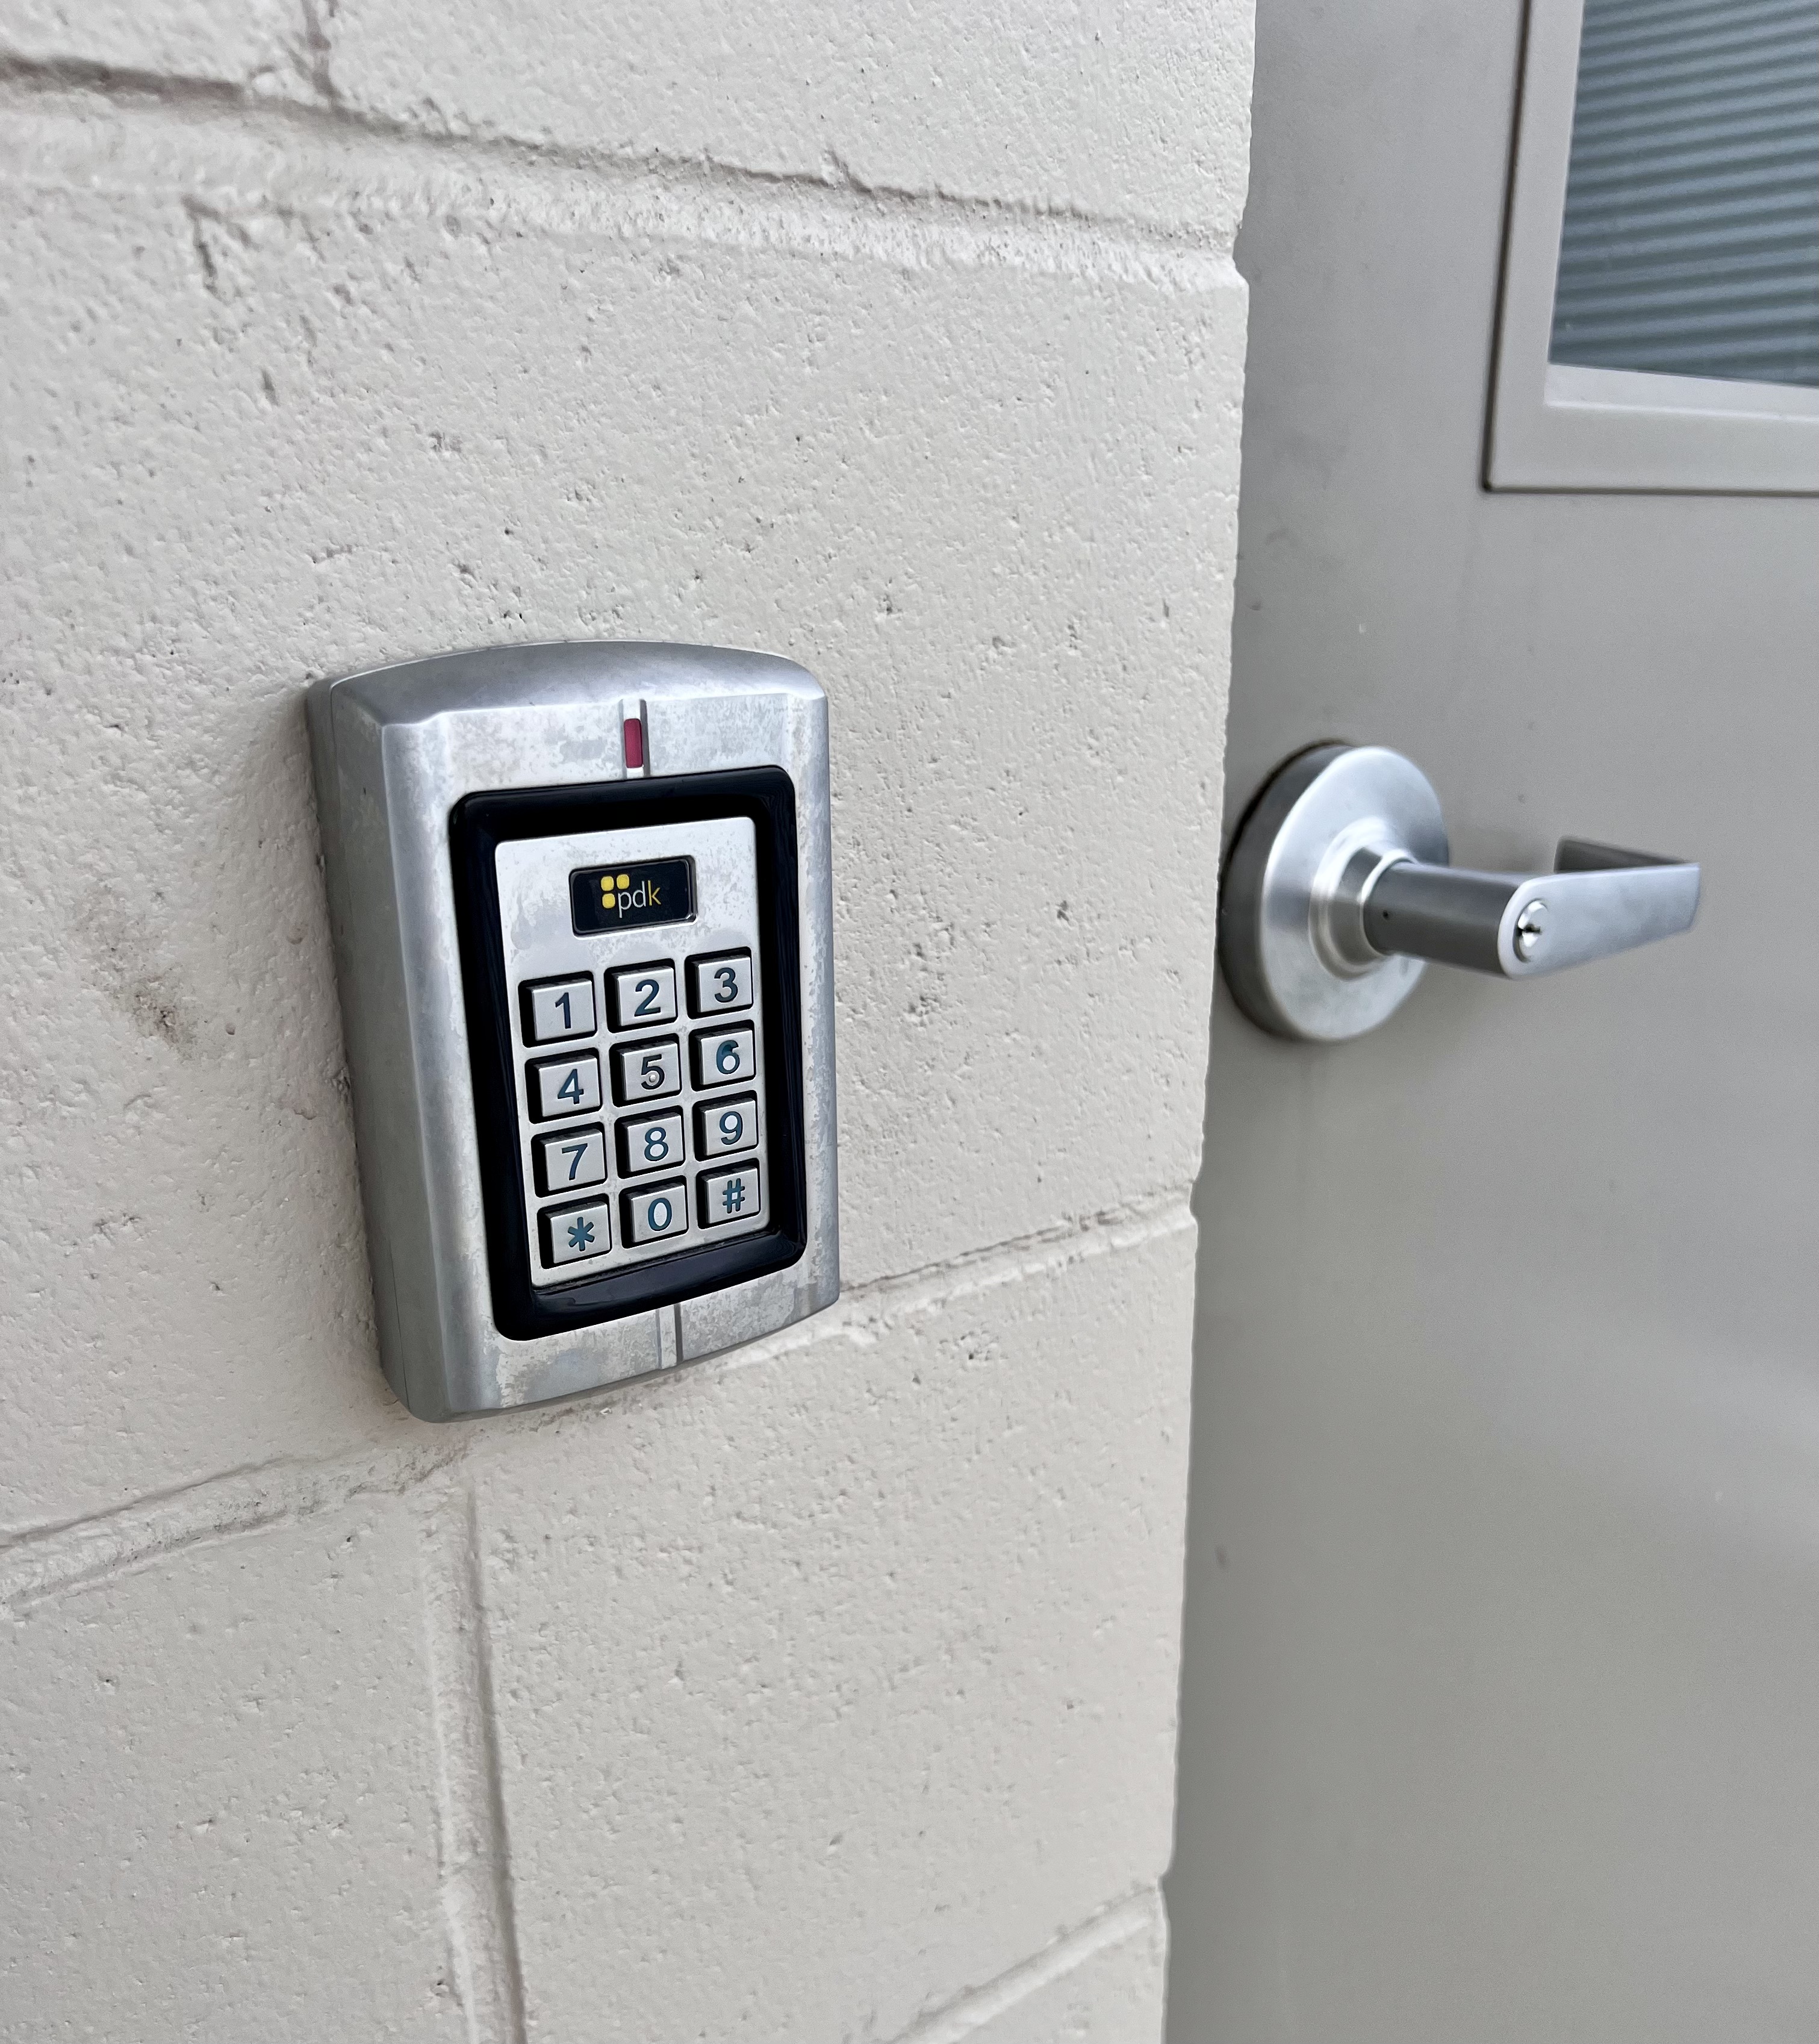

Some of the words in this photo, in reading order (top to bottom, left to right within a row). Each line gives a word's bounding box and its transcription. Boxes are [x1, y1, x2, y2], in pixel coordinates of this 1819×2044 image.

[618, 880, 662, 918] pdk
[555, 992, 571, 1029] 1
[634, 979, 661, 1017] 2
[714, 968, 738, 1003] 3
[558, 1069, 584, 1105] 4
[641, 1054, 665, 1089] 5
[716, 1040, 740, 1074] 6
[561, 1143, 588, 1180] 7
[644, 1127, 669, 1161] 8
[719, 1111, 742, 1145] 9
[648, 1198, 672, 1231] 0
[723, 1179, 745, 1214] #
